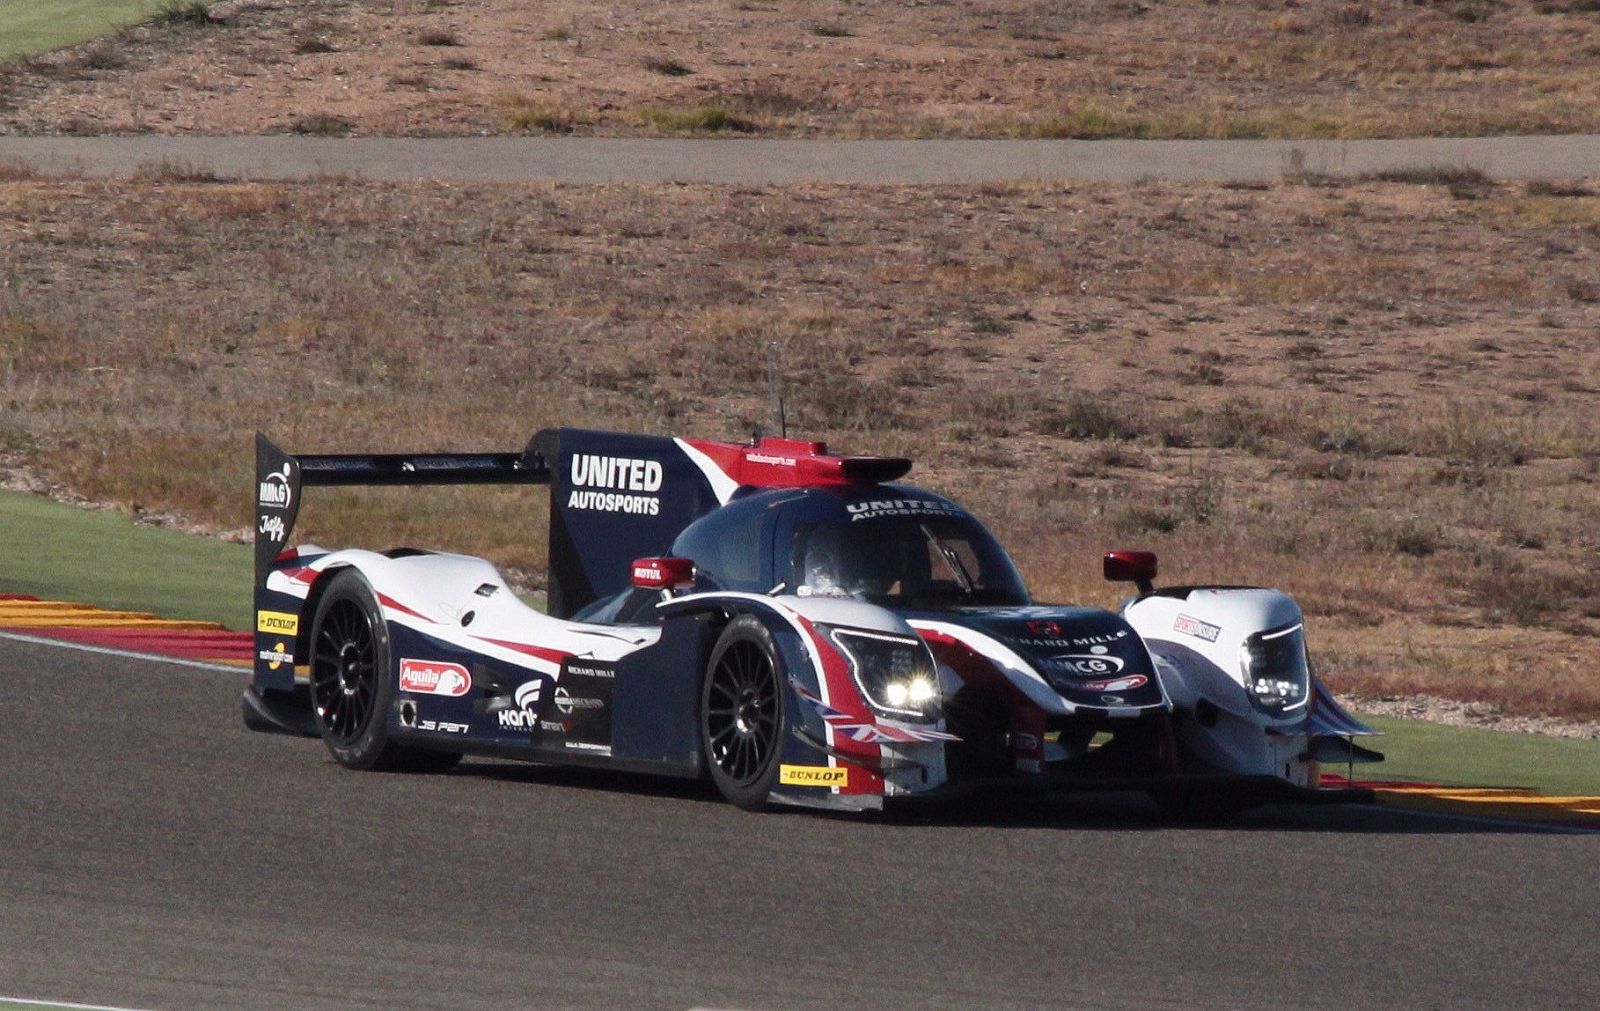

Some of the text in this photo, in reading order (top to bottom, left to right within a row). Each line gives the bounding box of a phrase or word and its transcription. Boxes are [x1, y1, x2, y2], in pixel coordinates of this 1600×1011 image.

[571, 453, 663, 492] UNITED
[568, 490, 660, 515] AUTOSPORTS
[846, 499, 962, 513] UNITED
[634, 567, 662, 581] MOTUL
[266, 617, 296, 630] DUNLOP
[1073, 629, 1128, 647] MILLE
[567, 665, 595, 677] RICHARD
[418, 720, 436, 731] JS
[789, 770, 844, 781] DUNLOP
